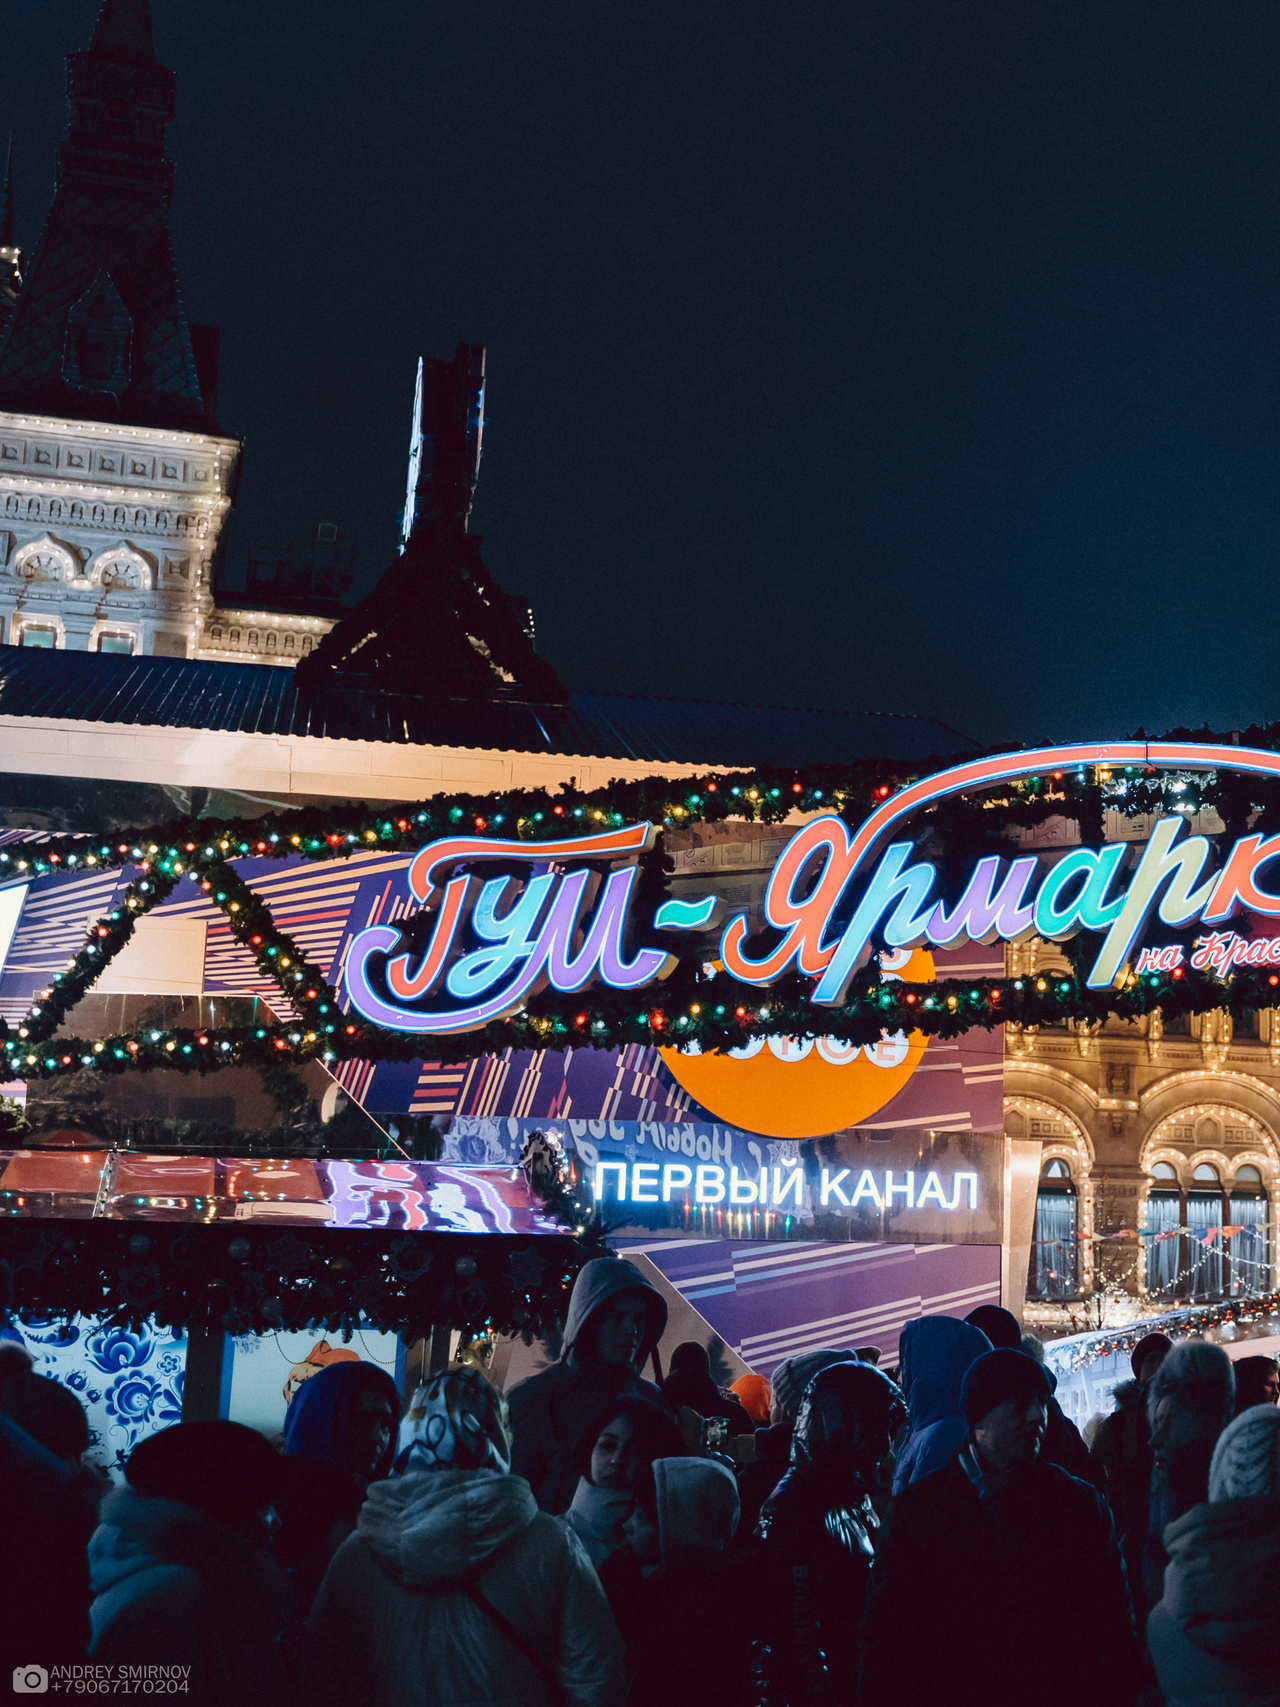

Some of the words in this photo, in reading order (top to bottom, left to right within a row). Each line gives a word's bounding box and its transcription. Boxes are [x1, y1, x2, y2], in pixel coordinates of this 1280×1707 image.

[1135, 943, 1184, 974] на
[595, 1157, 803, 1204] ПЕРВЫЙ
[820, 1168, 979, 1210] КАНАЛ
